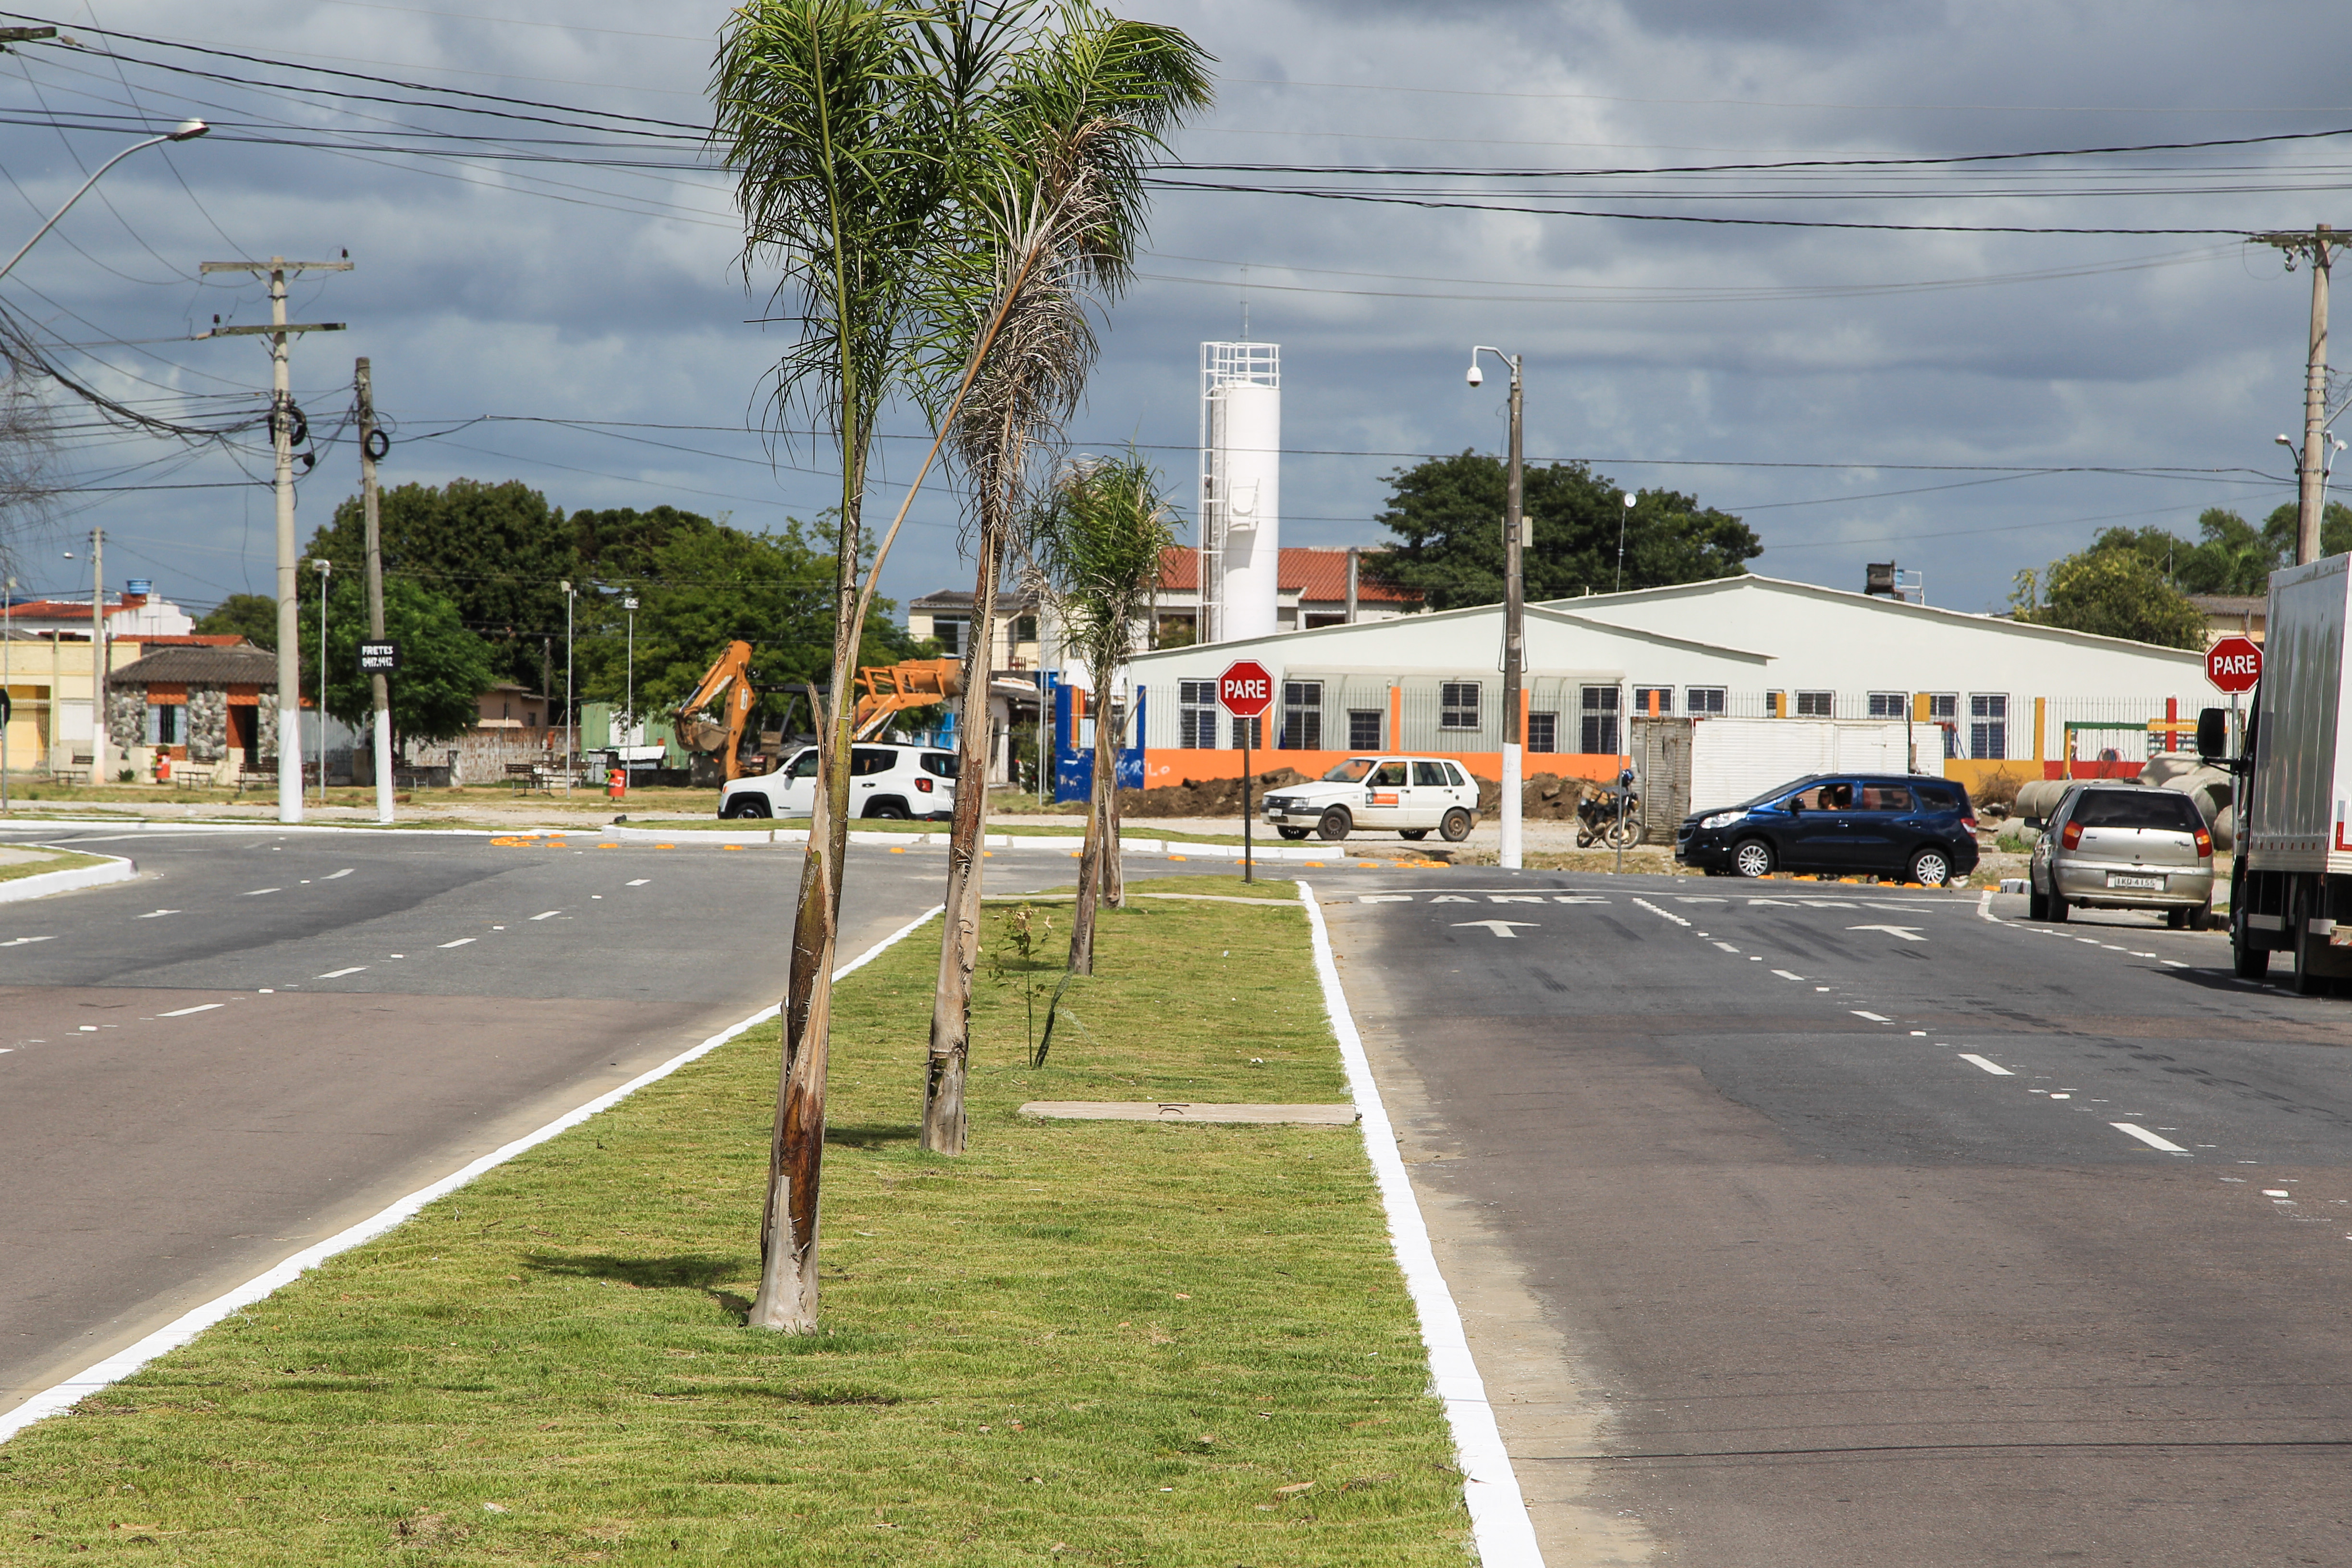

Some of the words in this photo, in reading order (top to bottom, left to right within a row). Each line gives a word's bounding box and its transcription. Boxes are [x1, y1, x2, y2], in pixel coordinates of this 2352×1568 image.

[361, 645, 393, 655] FRETES
[2214, 654, 2257, 675] PARE
[1224, 679, 1267, 699] PARE
